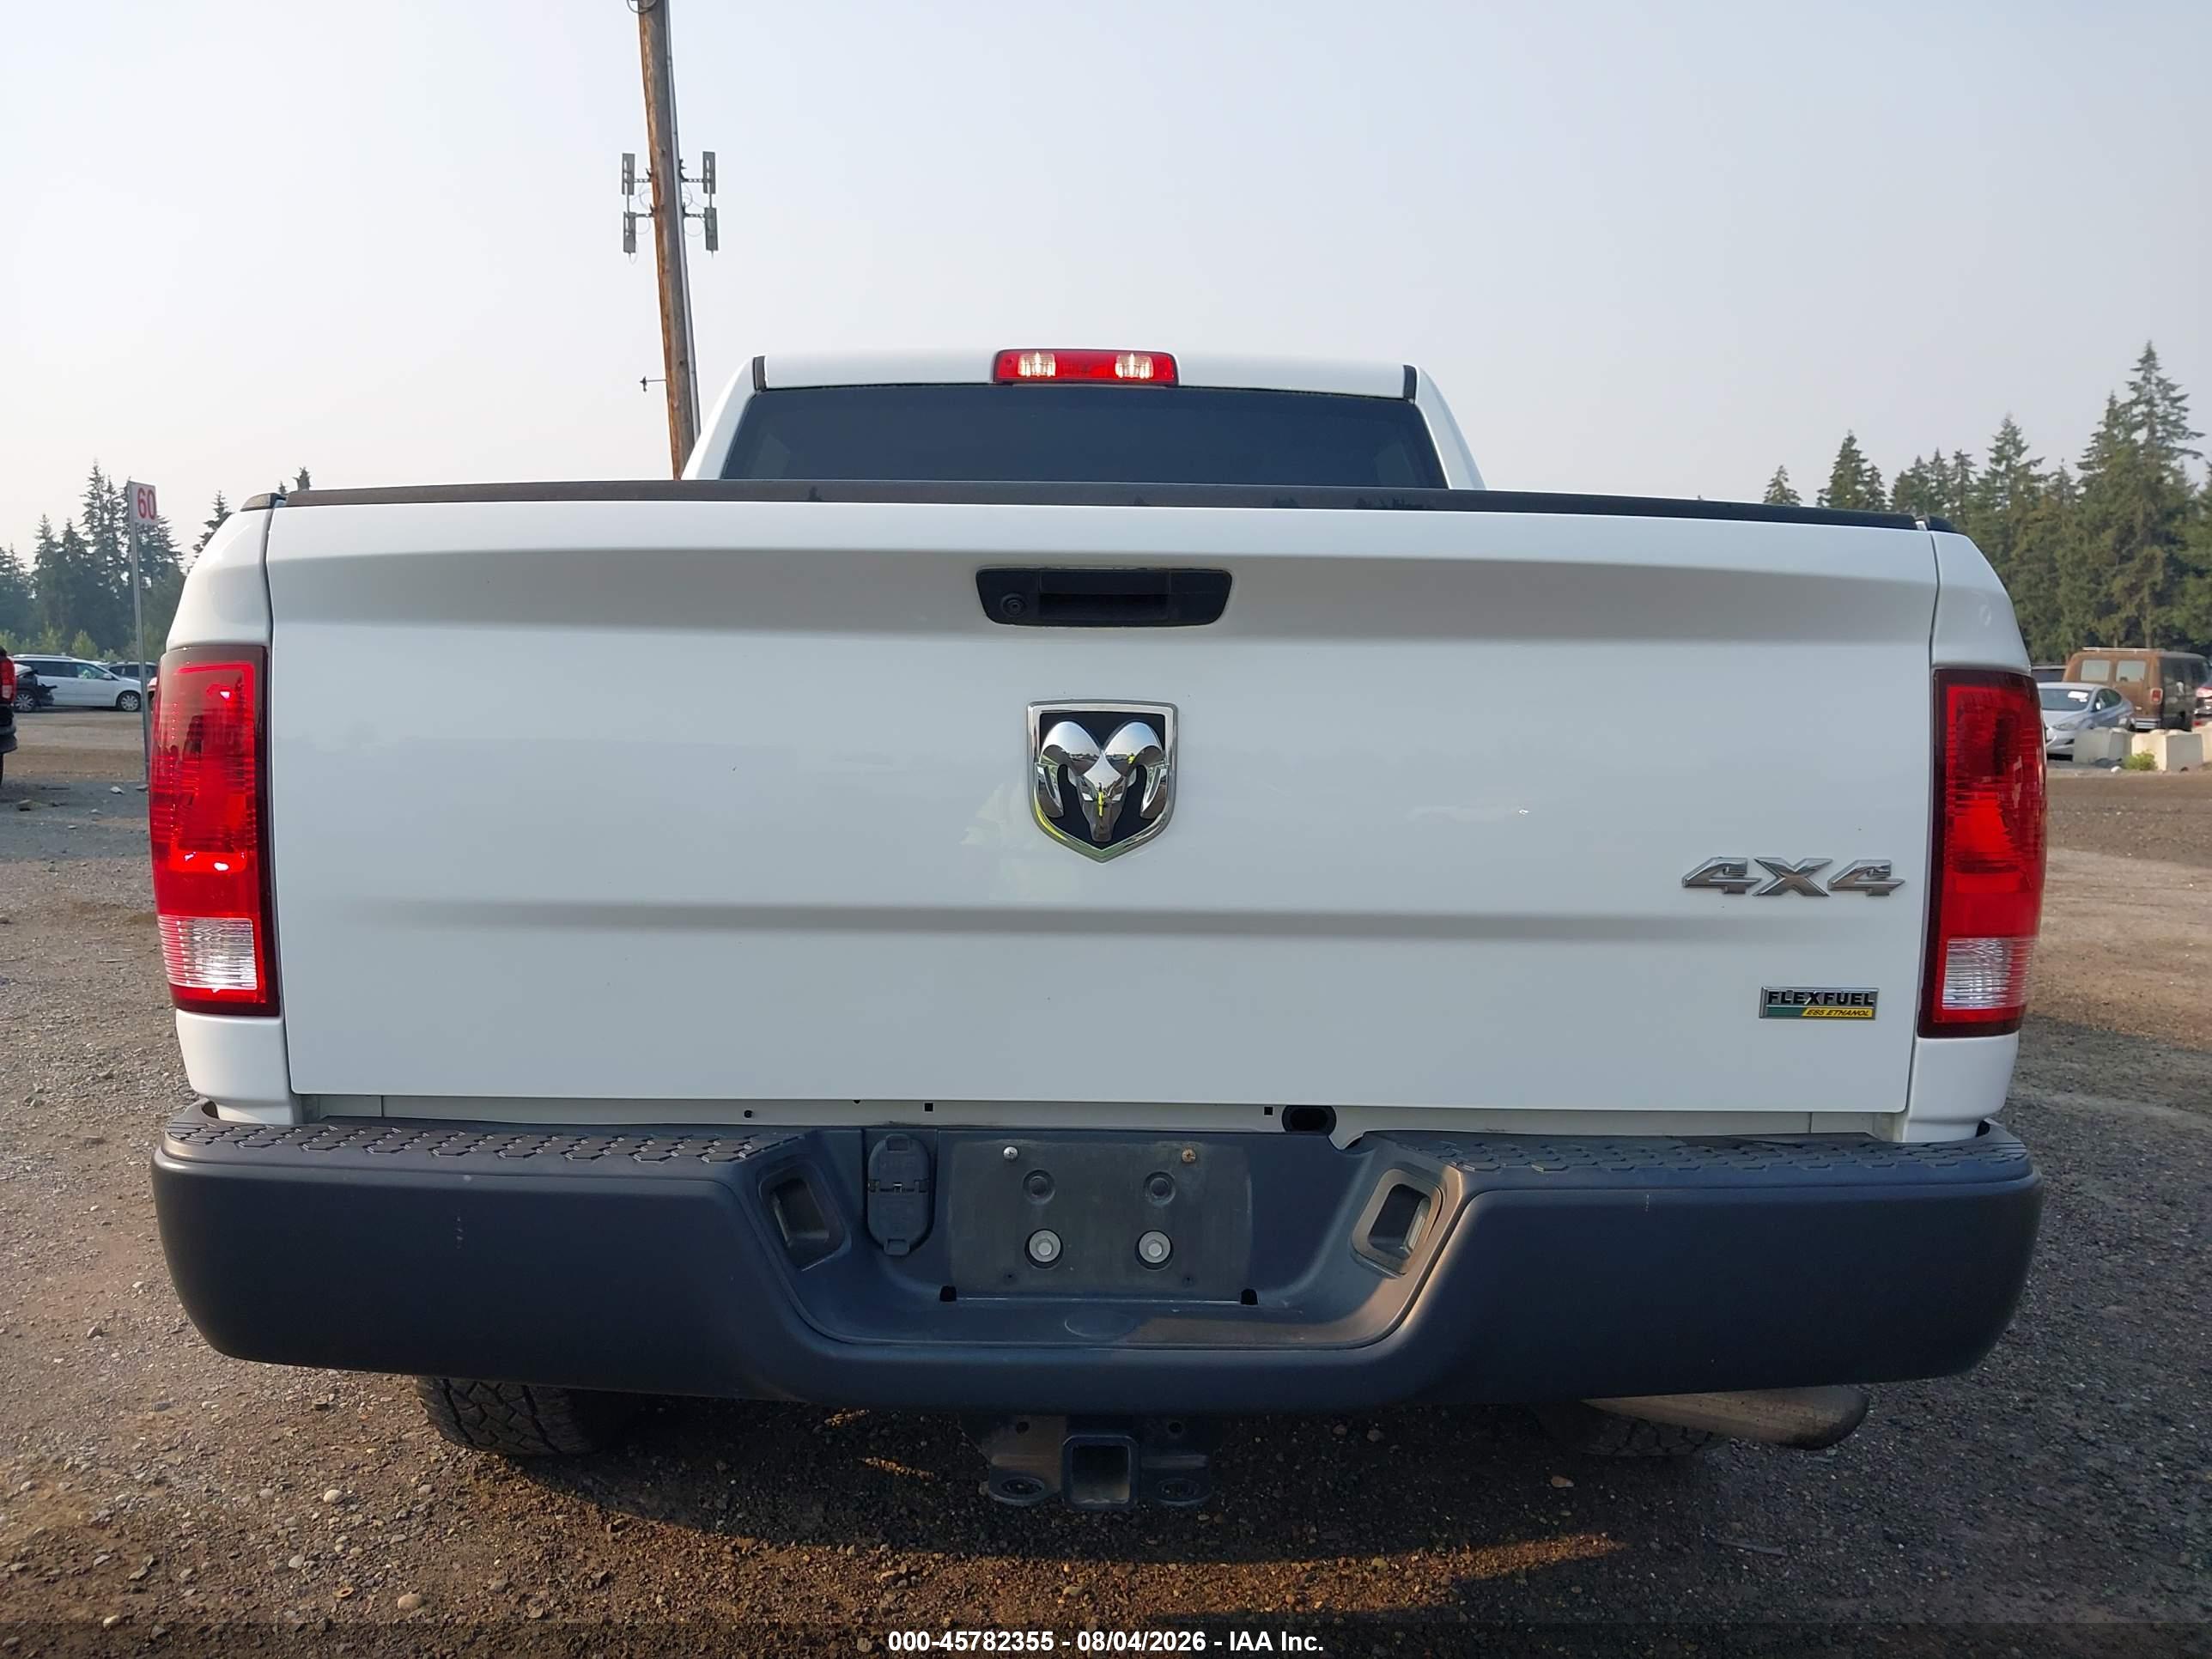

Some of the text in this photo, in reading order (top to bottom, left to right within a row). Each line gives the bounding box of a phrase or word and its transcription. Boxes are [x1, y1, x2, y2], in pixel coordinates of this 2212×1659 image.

[137, 487, 157, 520] 60
[1681, 856, 1905, 896] 4X4
[1768, 990, 1875, 1006] FLEXFUEL
